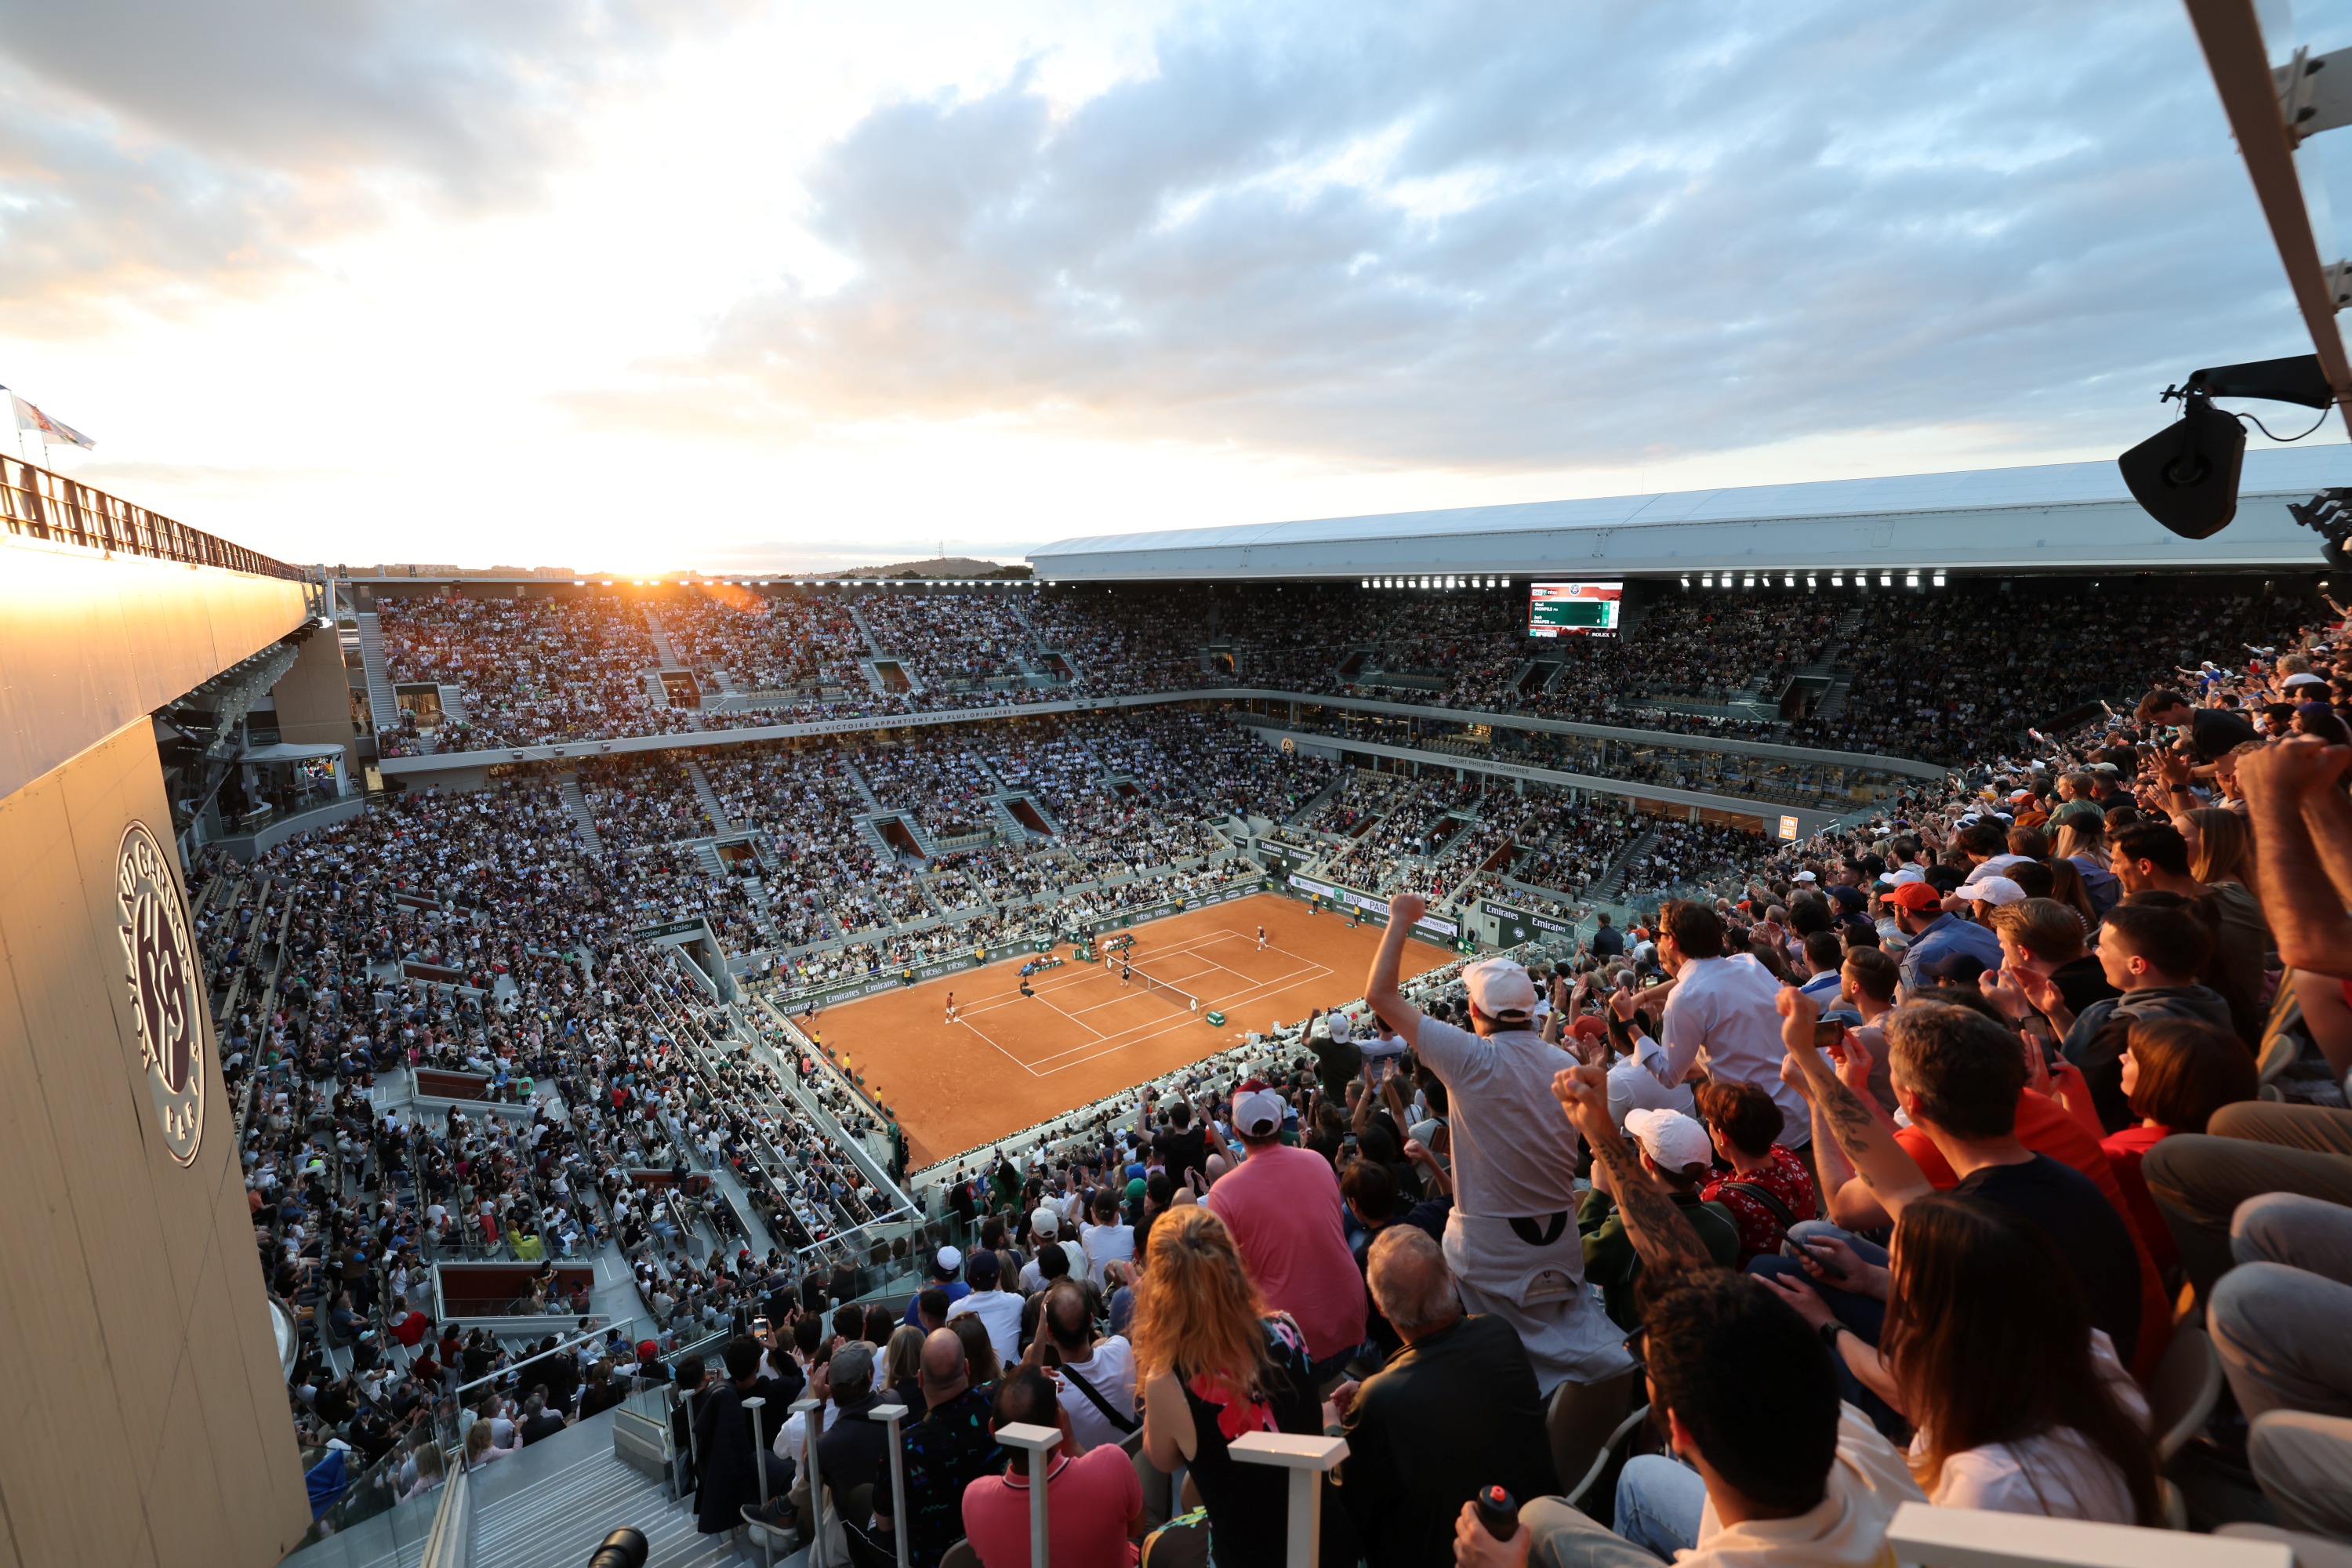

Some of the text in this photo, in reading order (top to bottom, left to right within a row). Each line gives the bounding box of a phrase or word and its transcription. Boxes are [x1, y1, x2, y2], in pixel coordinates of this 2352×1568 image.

[825, 722, 869, 731] VICTOIRE
[874, 717, 928, 727] APPARTIENT
[970, 709, 1012, 718] OPINIÂTRE
[1469, 760, 1494, 769] PHILIPPE
[1499, 765, 1530, 774] CHATRIER
[1783, 818, 1795, 827] TEN
[1782, 828, 1793, 837] NIS
[1261, 841, 1311, 861] Emirates Emirates
[1309, 882, 1324, 891] PARIBAS
[135, 839, 191, 985] GARROS
[1345, 893, 1390, 914] BNP PARI
[1136, 907, 1171, 922] Infosys Infosys
[1486, 904, 1566, 932] Emirates Emirates
[638, 923, 692, 939] Haier Haier
[1430, 920, 1449, 930] PARIBAS
[1424, 932, 1439, 941] PARIBAS
[921, 960, 968, 978] Infosys Infosys
[826, 989, 860, 1004] Emirates
[865, 979, 898, 993] Emirates
[164, 1040, 199, 1142] PARIS
